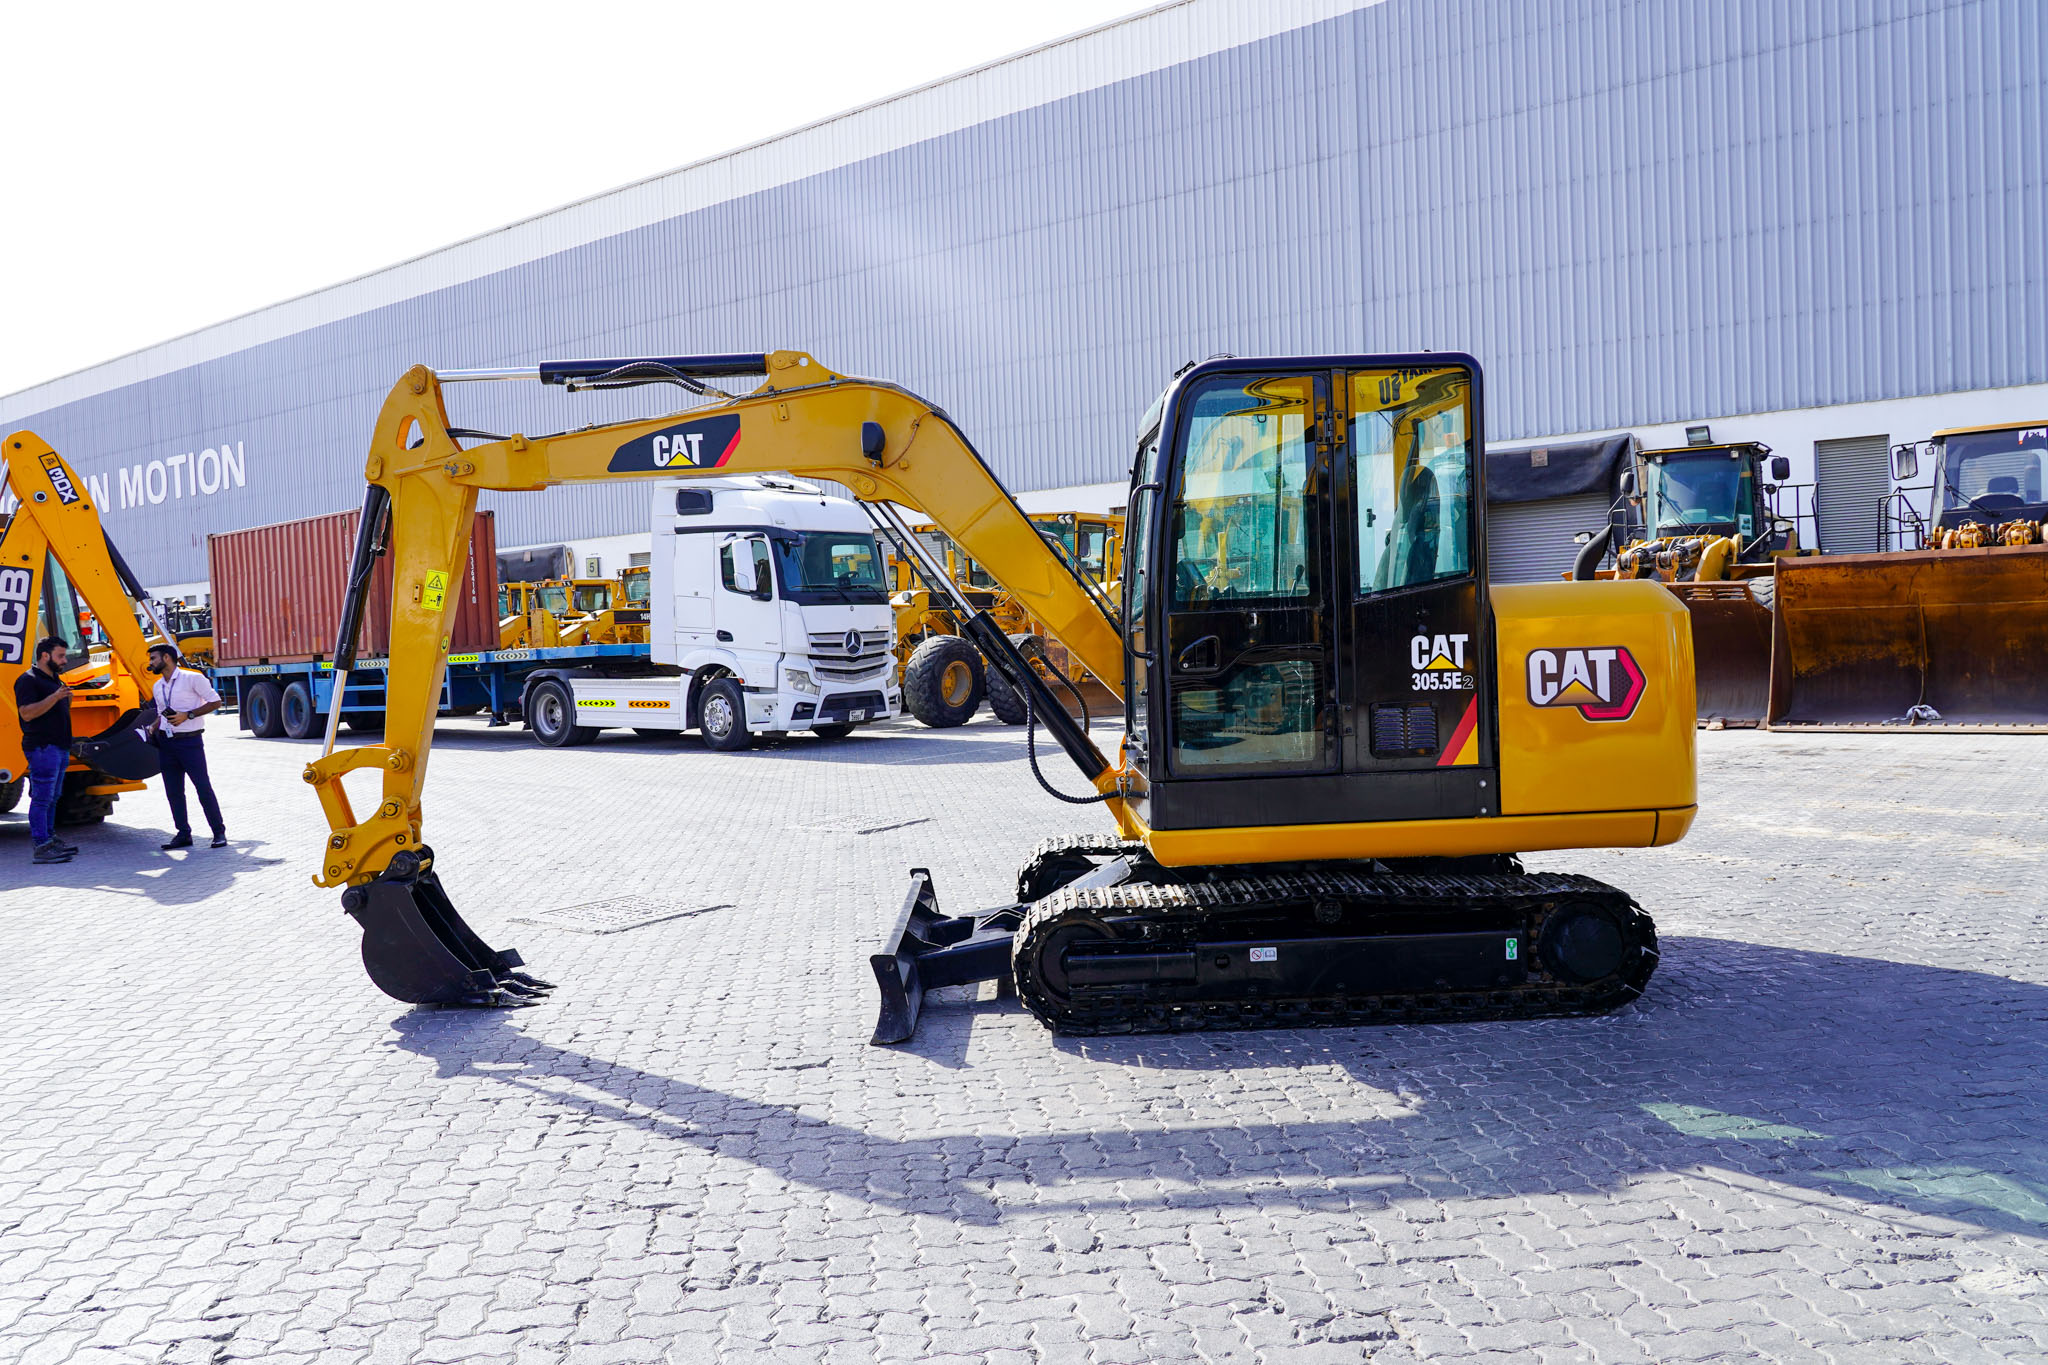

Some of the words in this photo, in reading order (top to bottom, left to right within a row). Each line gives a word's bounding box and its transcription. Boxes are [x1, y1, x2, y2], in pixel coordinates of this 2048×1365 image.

[653, 433, 703, 467] CAT
[48, 467, 79, 503] 3DX
[119, 441, 246, 510] MOTION
[589, 562, 595, 573] 5
[0, 569, 30, 661] JCB
[1411, 634, 1469, 670] CAT
[1529, 649, 1617, 705] CAT
